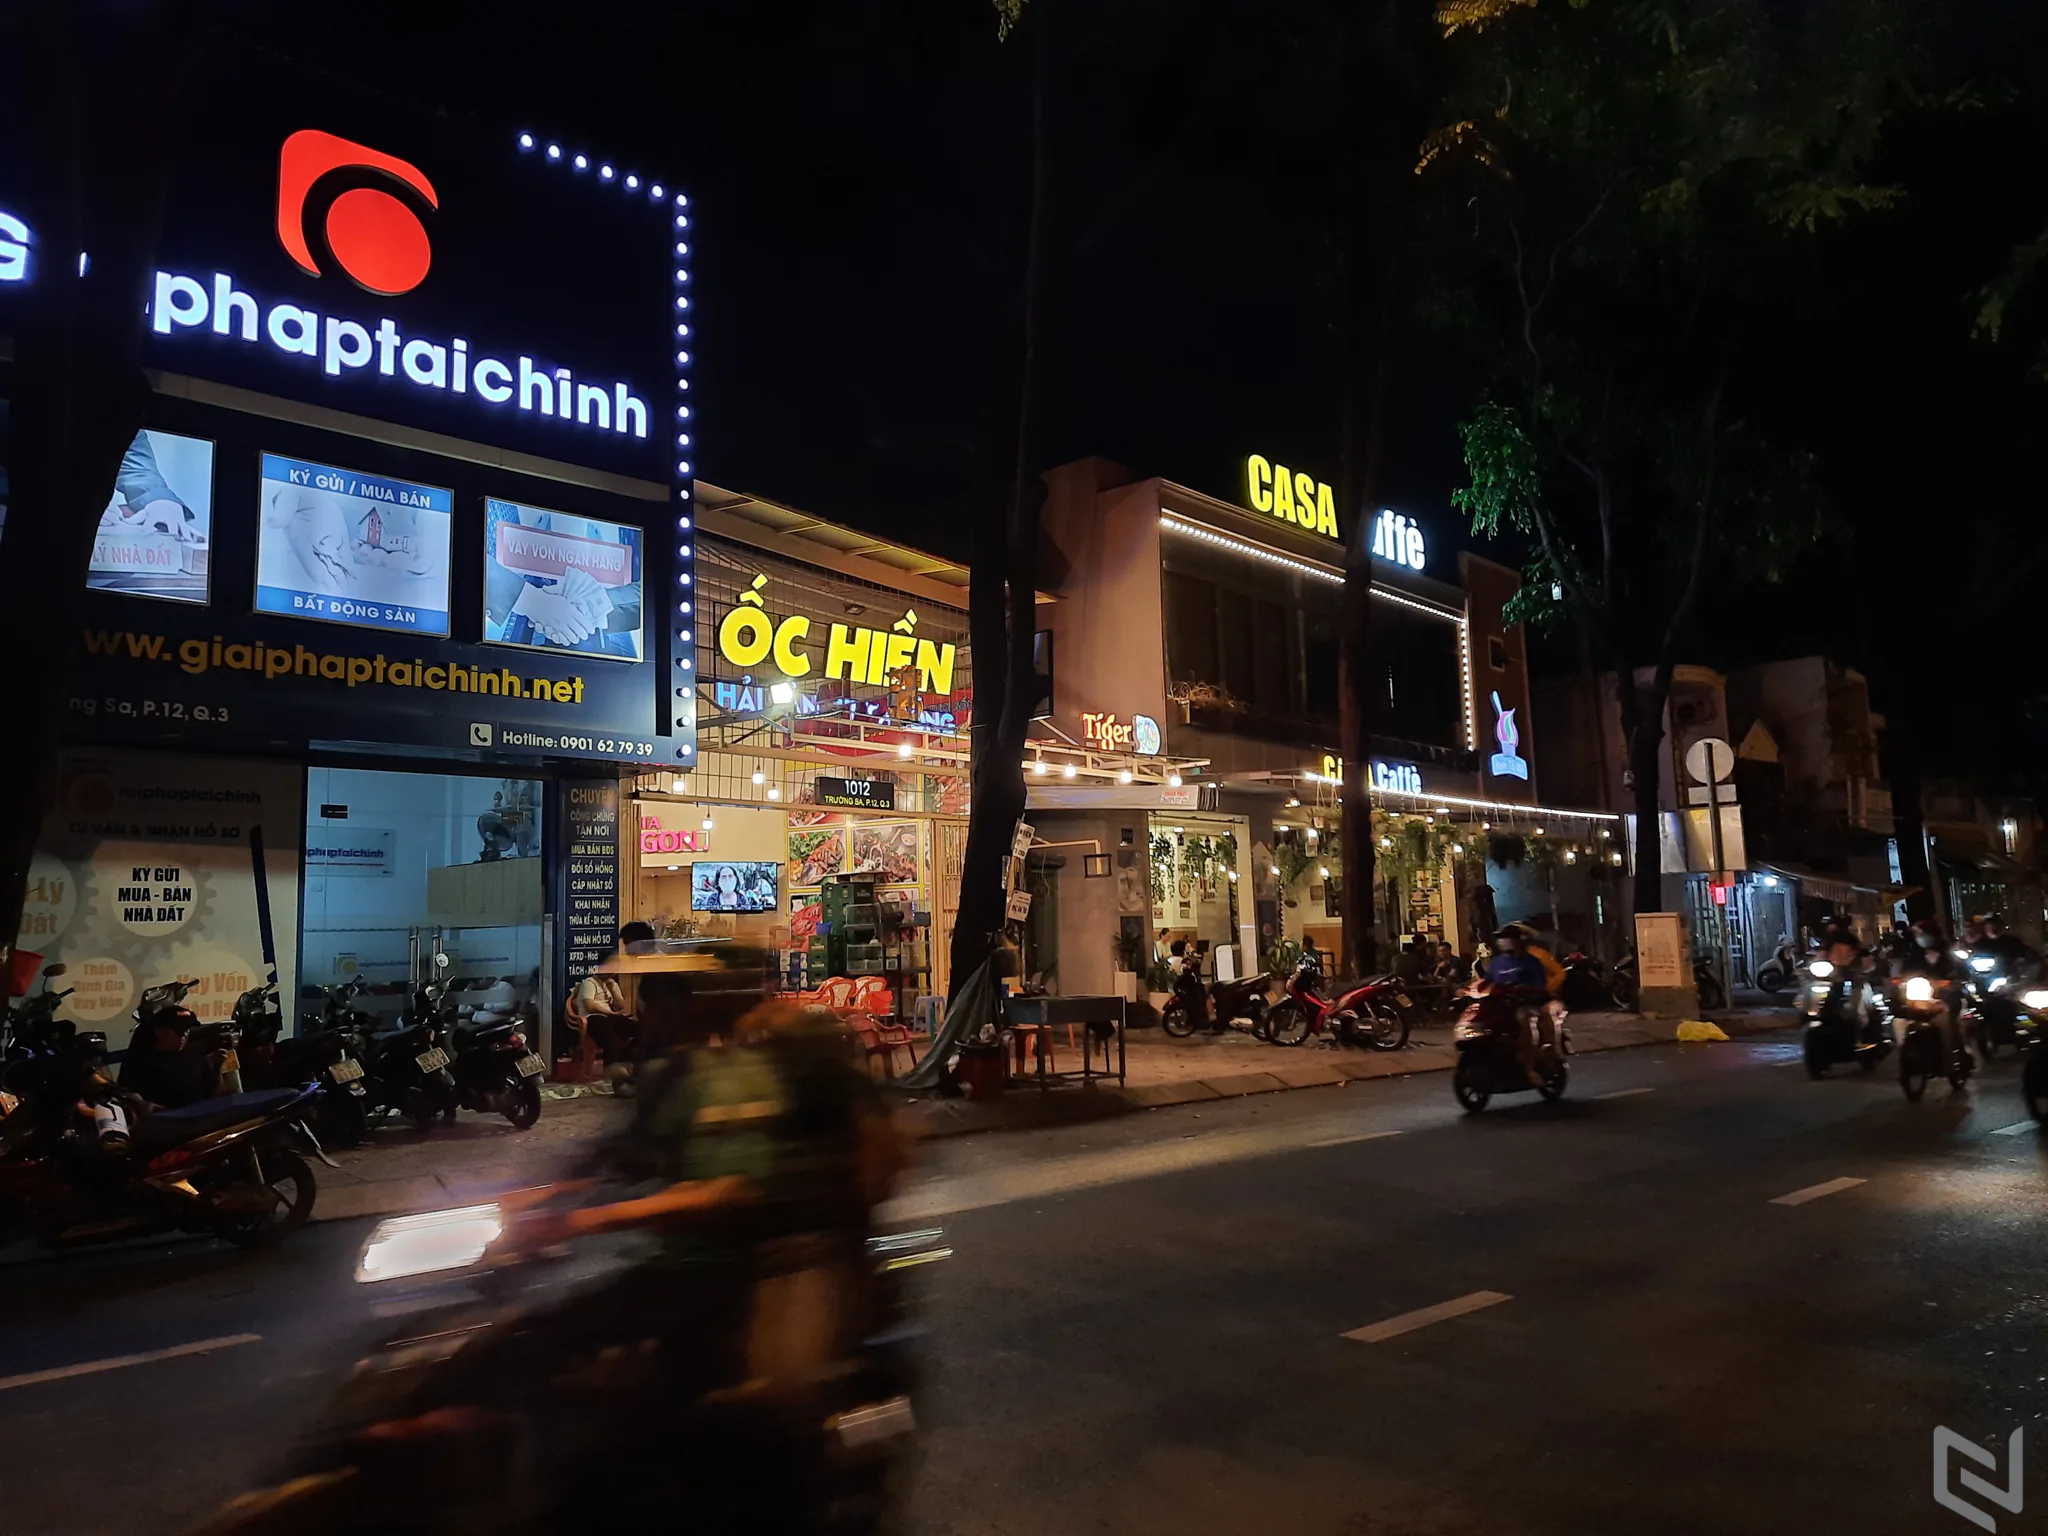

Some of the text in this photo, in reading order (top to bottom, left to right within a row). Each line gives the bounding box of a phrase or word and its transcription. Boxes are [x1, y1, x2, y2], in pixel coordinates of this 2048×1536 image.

[289, 469, 311, 485] KÝ
[315, 473, 345, 492] GỬI
[360, 484, 395, 502] MUA
[399, 491, 431, 508] BÁN
[1248, 454, 1339, 538] CASA
[111, 543, 142, 565] NHÀ
[145, 543, 172, 566] ĐẤT
[507, 540, 529, 556] VAY
[293, 594, 416, 623] BẤT ĐỘNG SẢN
[719, 573, 811, 677] ỐC
[715, 674, 765, 711] HẢI
[192, 705, 229, 722] Q.3
[1080, 712, 1133, 751] Tiger
[502, 731, 653, 757] Hotline: 0901 62 79 39
[844, 780, 871, 796] 1012
[825, 795, 854, 806] TRƯỜNG
[594, 824, 610, 837] NƠI
[132, 865, 151, 882] KÝ
[118, 887, 151, 902] MUA
[163, 885, 192, 902] BÁN
[123, 904, 185, 922] NHÀ ĐẤT
[575, 899, 590, 909] KHAI
